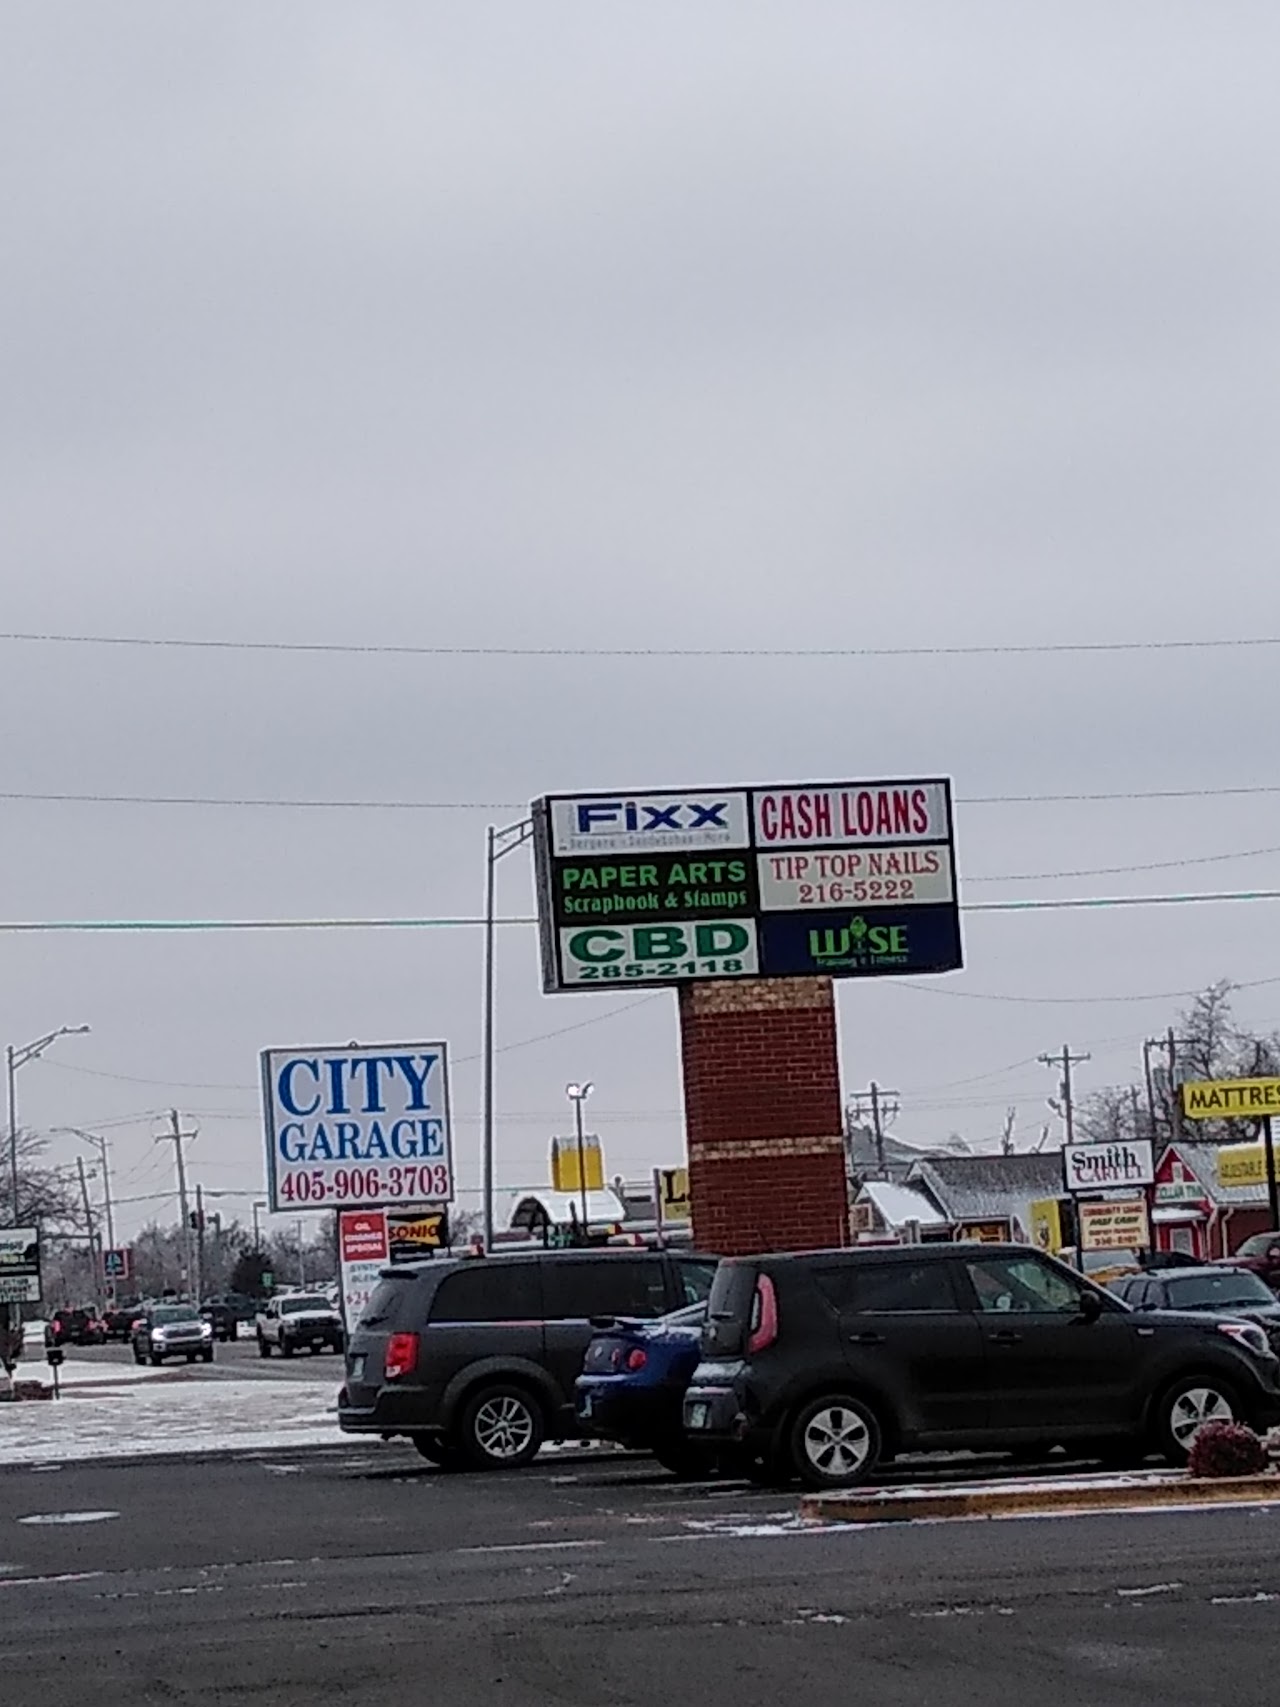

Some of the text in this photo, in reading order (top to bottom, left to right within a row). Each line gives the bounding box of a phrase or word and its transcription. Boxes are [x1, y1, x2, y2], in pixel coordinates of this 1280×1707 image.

[577, 801, 729, 832] Fixx
[761, 789, 928, 840] CASH LOANS
[563, 861, 747, 890] PAPER ARTS
[770, 850, 939, 880] TIP TOP NAILS
[564, 890, 747, 914] Scrapbook & Stamps
[799, 879, 914, 904] 216-5222
[569, 923, 749, 962] CBD
[579, 959, 743, 979] 285-2118
[278, 1055, 438, 1116] CITY
[1189, 1085, 1280, 1110] MATTRE
[279, 1119, 443, 1162] GARAGE
[1071, 1145, 1139, 1171] Smith
[281, 1165, 447, 1201] 405-906-3703
[388, 1224, 440, 1239] SONIC
